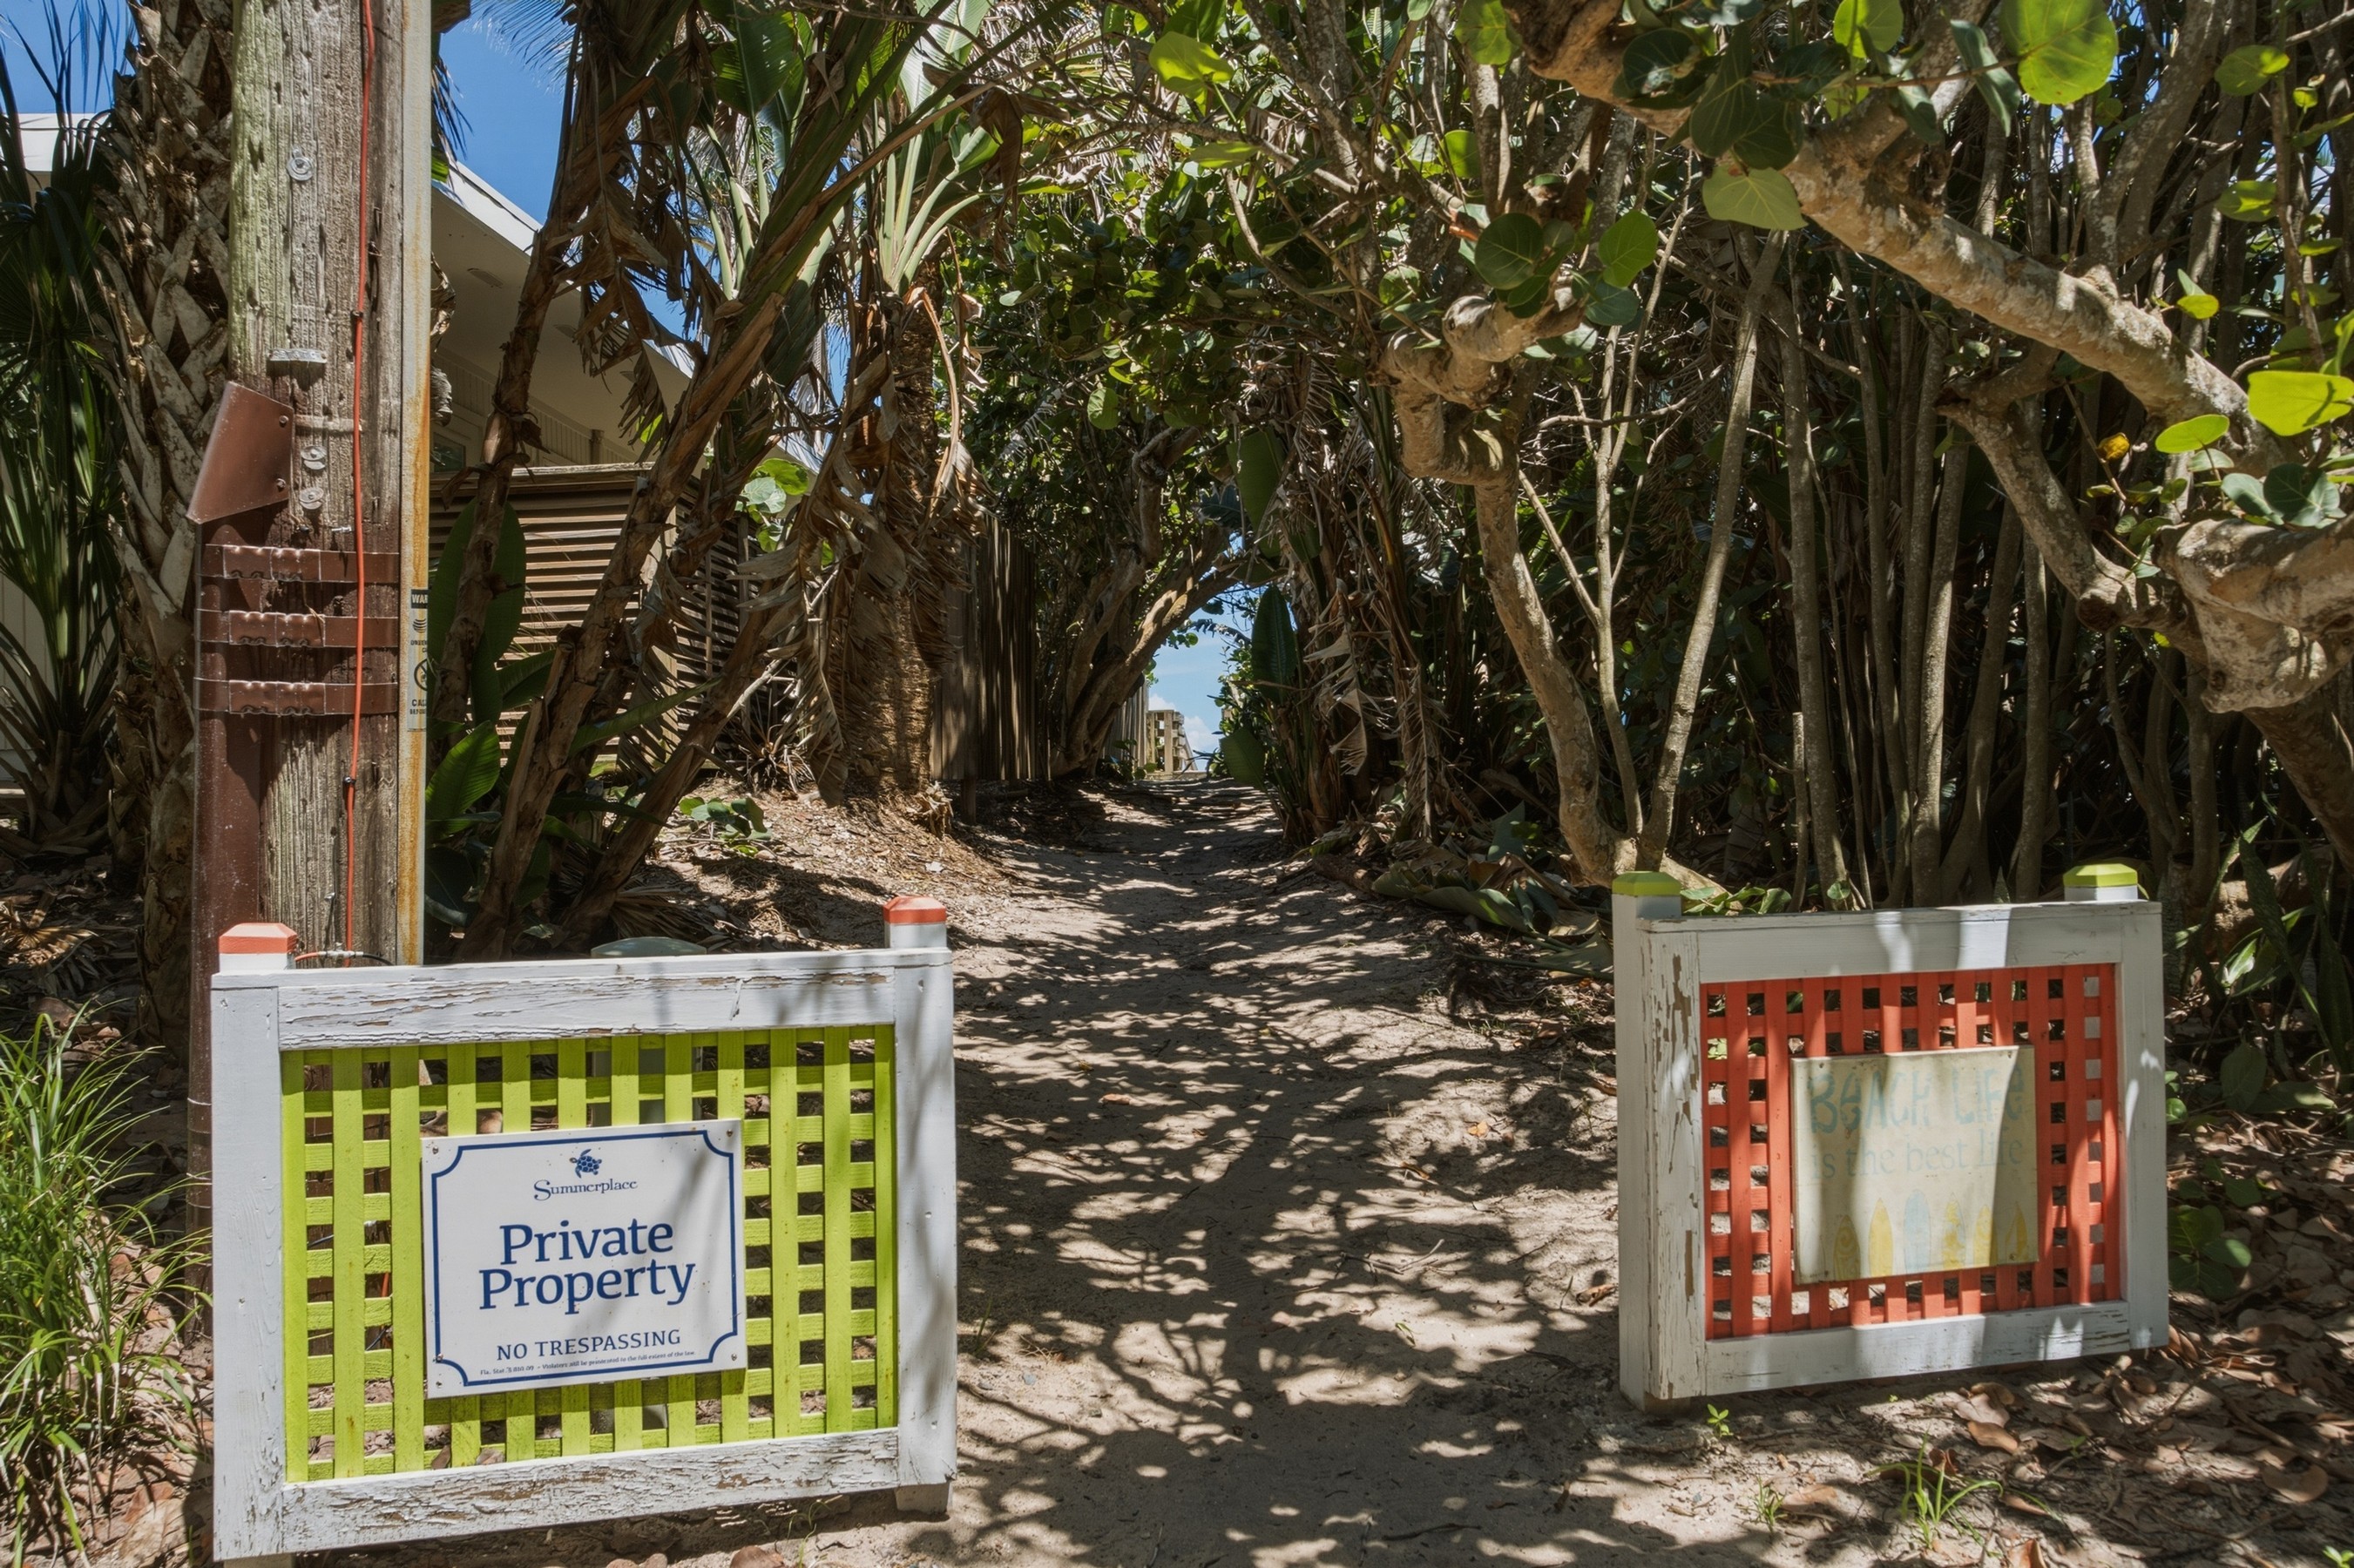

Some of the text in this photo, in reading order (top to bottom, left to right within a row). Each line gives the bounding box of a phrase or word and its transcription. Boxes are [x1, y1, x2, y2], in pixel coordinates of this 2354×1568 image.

[1812, 1126, 2023, 1179] is the best life
[533, 1179, 638, 1201] Summerplace
[499, 1218, 673, 1265] Private
[478, 1259, 696, 1315] Property
[497, 1329, 681, 1361] NO TRESPASSING
